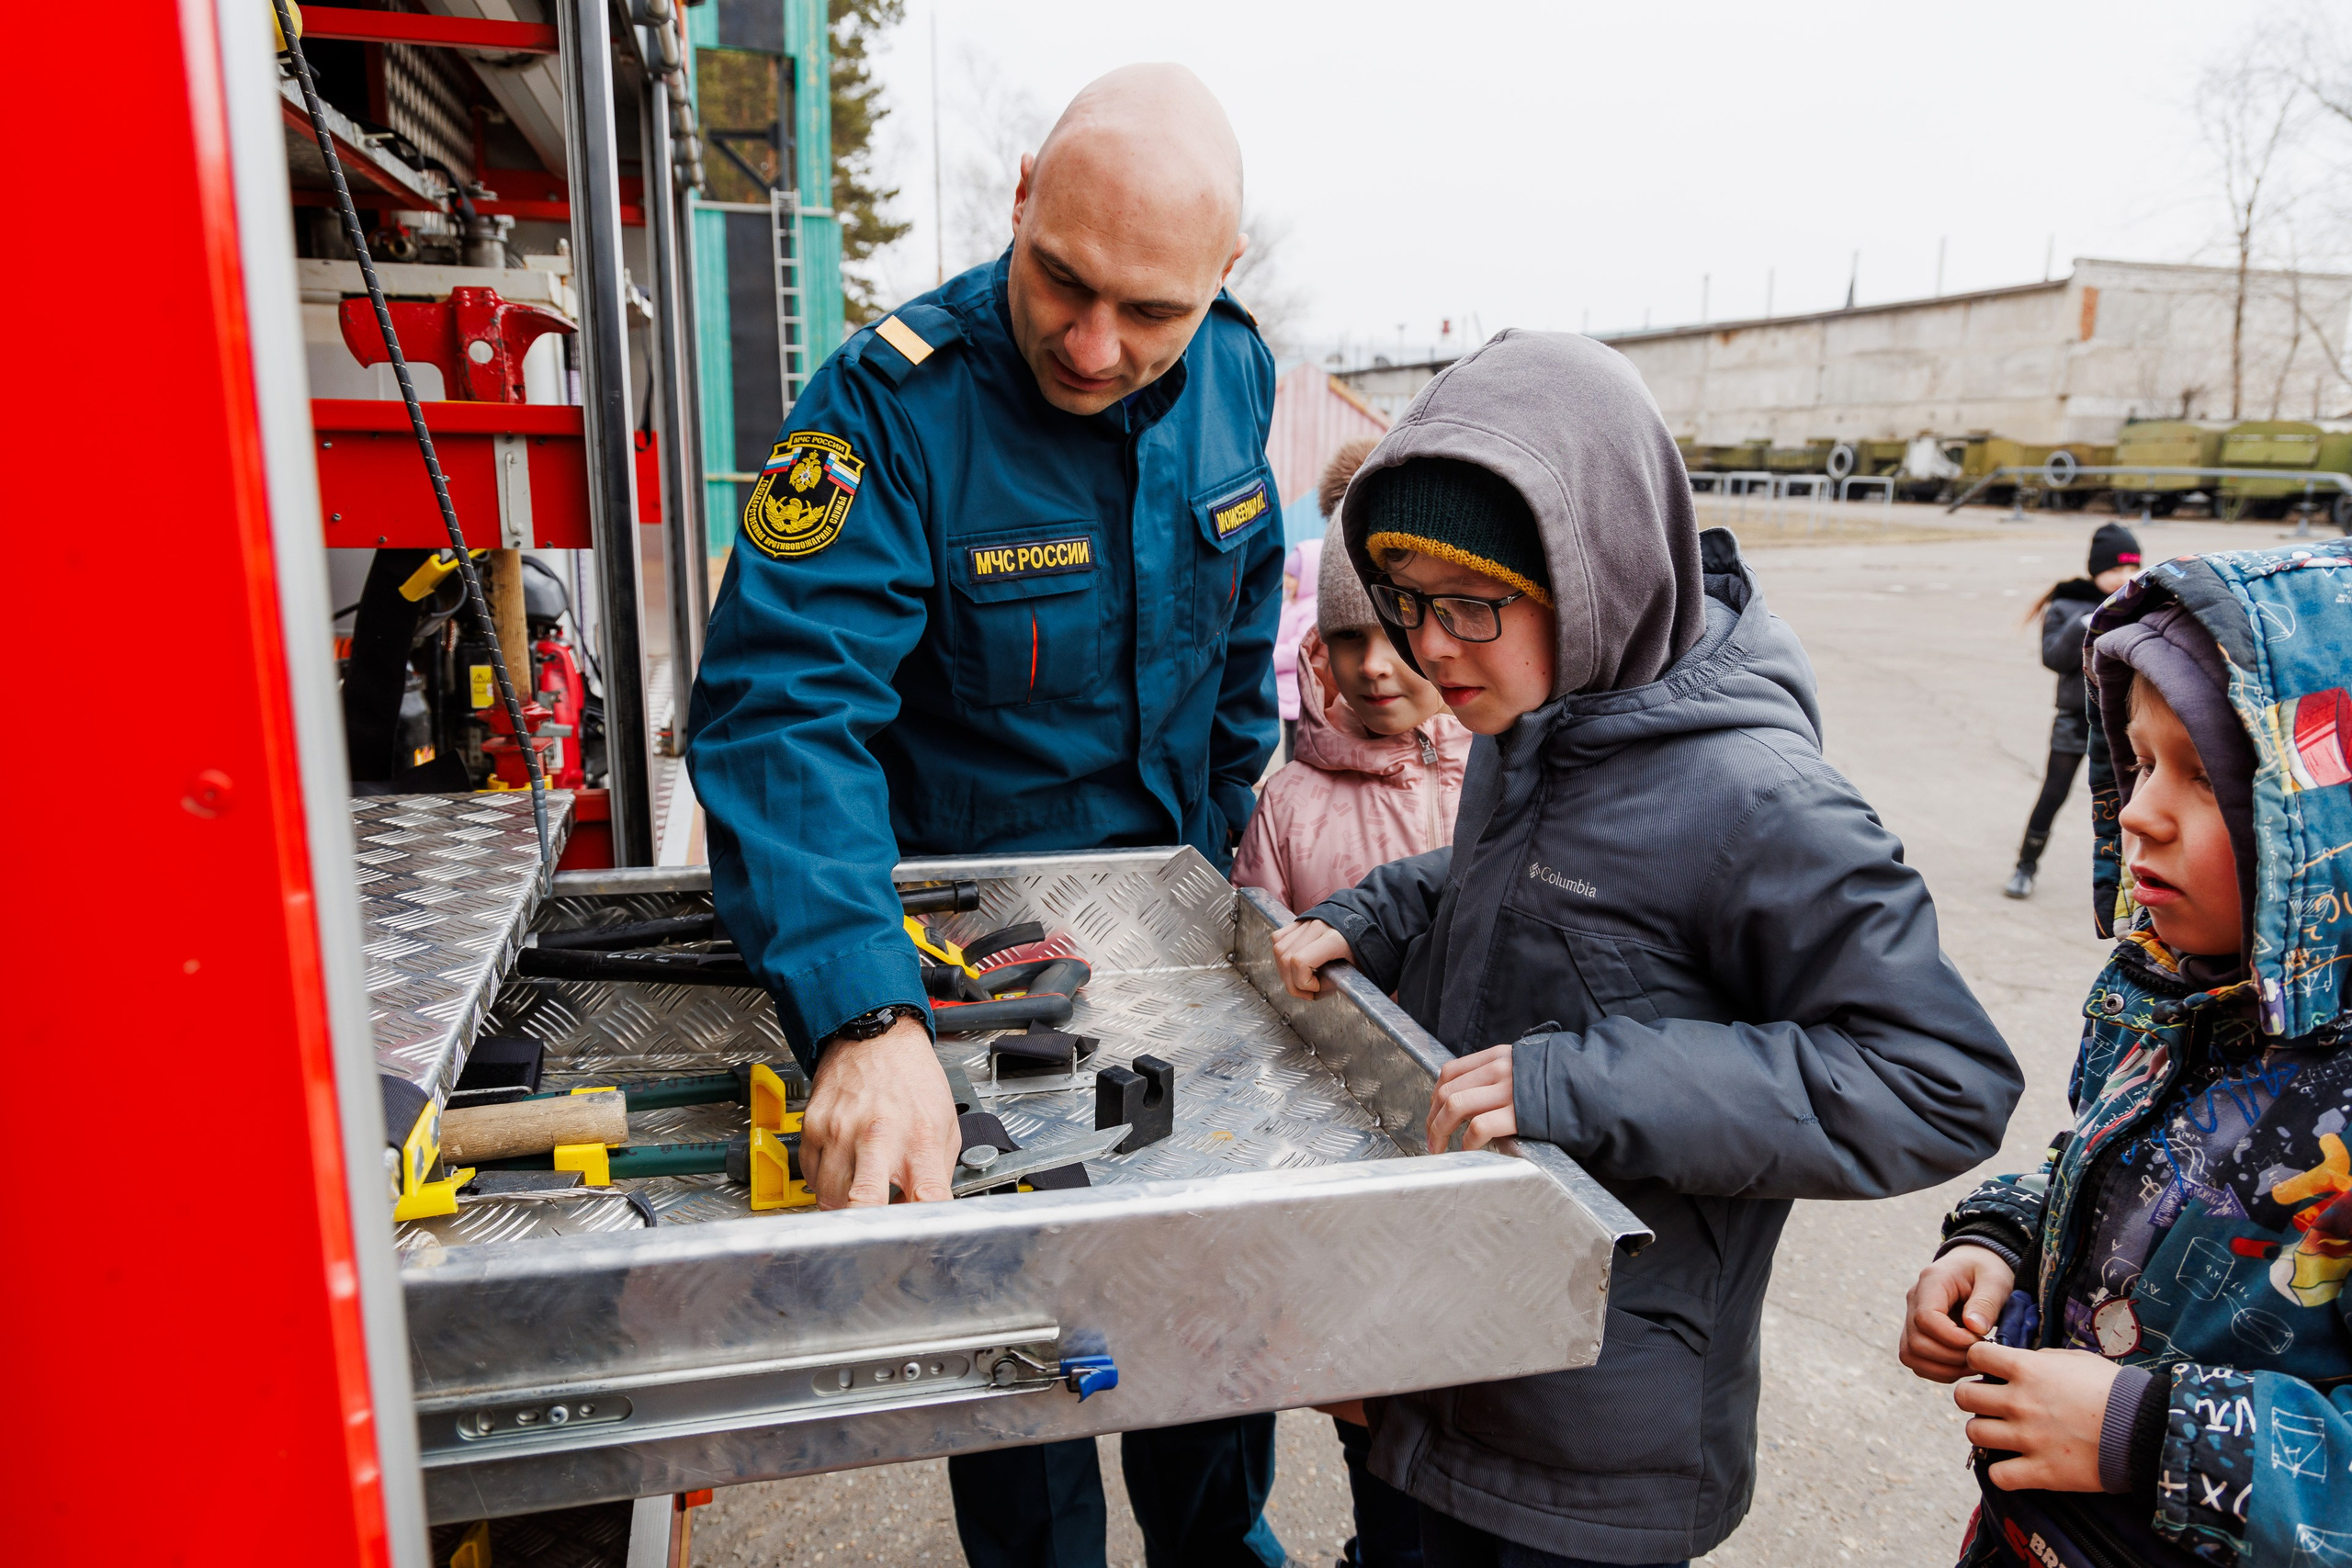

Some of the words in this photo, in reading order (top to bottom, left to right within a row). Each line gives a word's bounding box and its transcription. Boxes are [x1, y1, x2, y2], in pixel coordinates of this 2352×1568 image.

[812, 436, 845, 453] РОССИИ
[747, 479, 769, 542] ГОСУДАРСТВЕННАЯ
[763, 525, 834, 551] ПРОТИВОПОЖАРНАЯ
[829, 496, 848, 525] СЛУЖБА
[975, 548, 1016, 575] МЧС
[1017, 541, 1091, 570] РОССИИ
[1540, 866, 1597, 898] Columbia
[2029, 1531, 2067, 1568] BR
